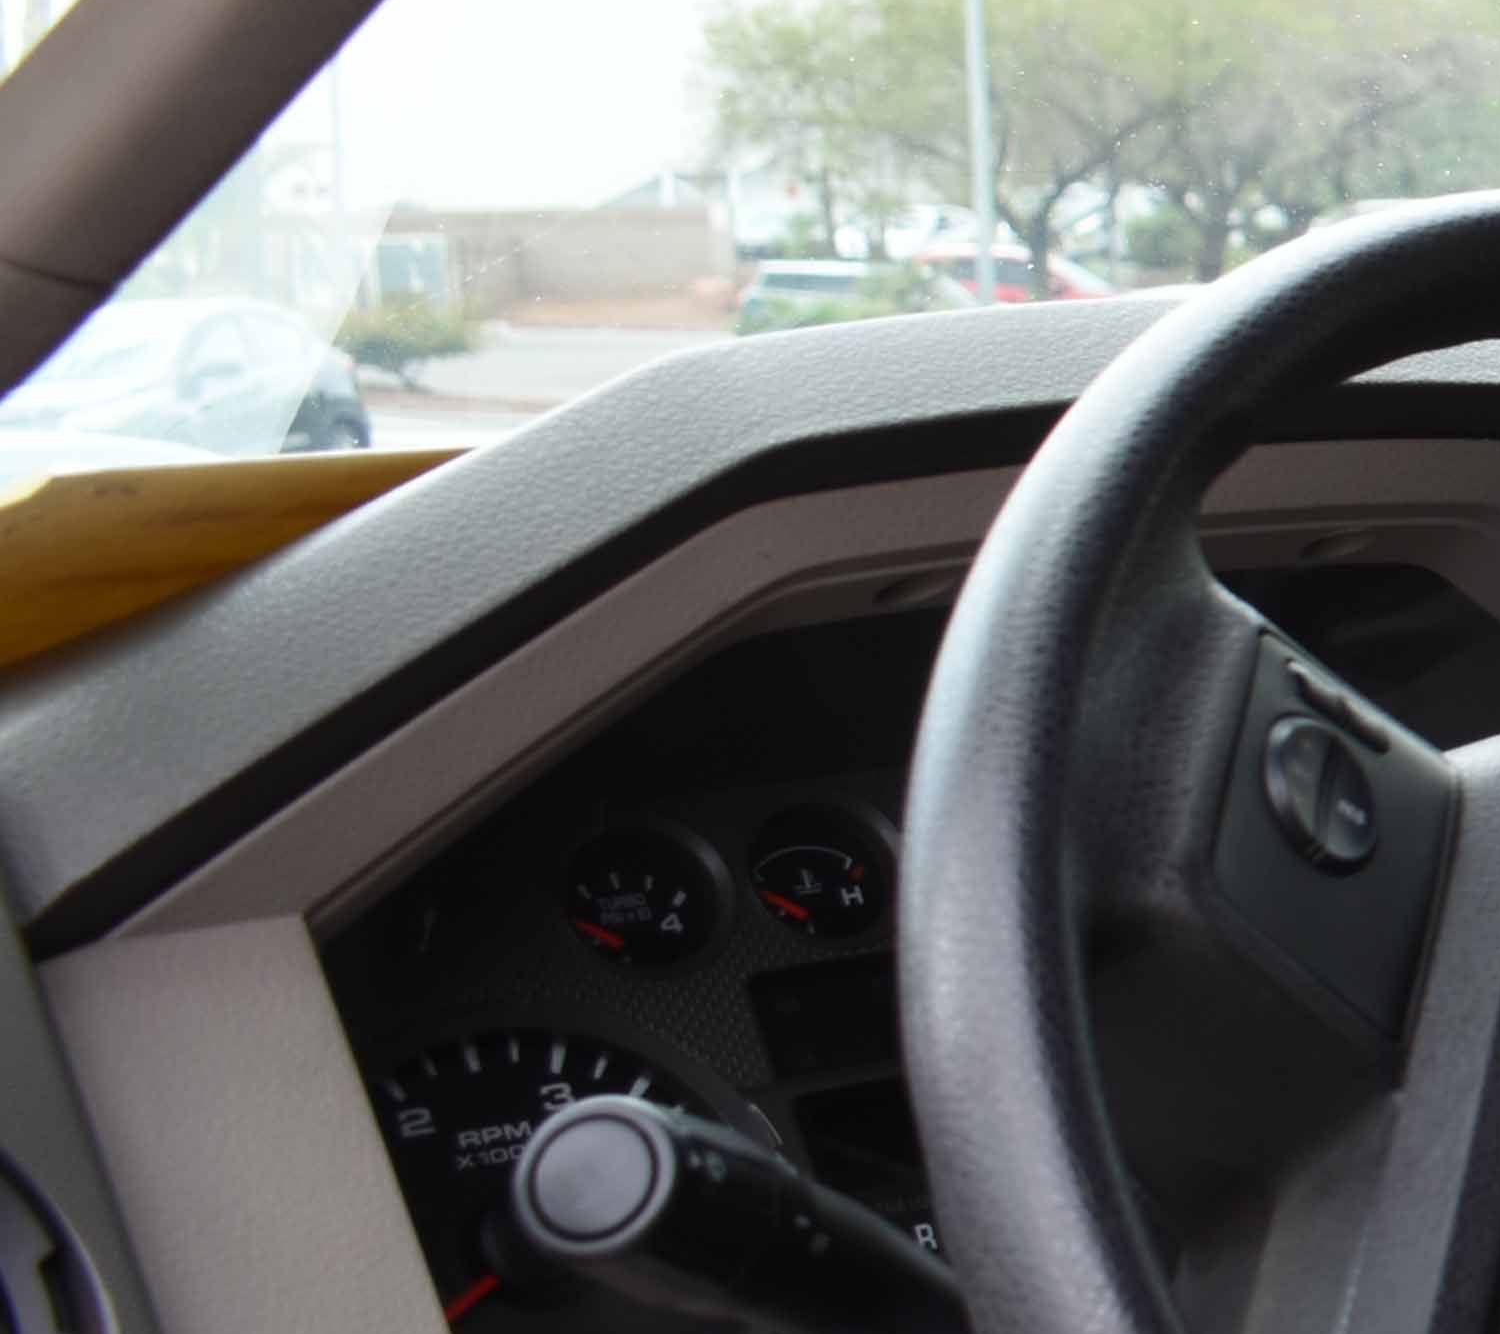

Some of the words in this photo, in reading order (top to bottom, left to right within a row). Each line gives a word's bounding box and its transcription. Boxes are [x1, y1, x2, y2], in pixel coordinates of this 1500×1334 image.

[840, 886, 865, 906] H
[660, 912, 685, 933] 4
[541, 1083, 576, 1113] 3
[400, 1107, 436, 1138] 2
[457, 1120, 533, 1149] RPM
